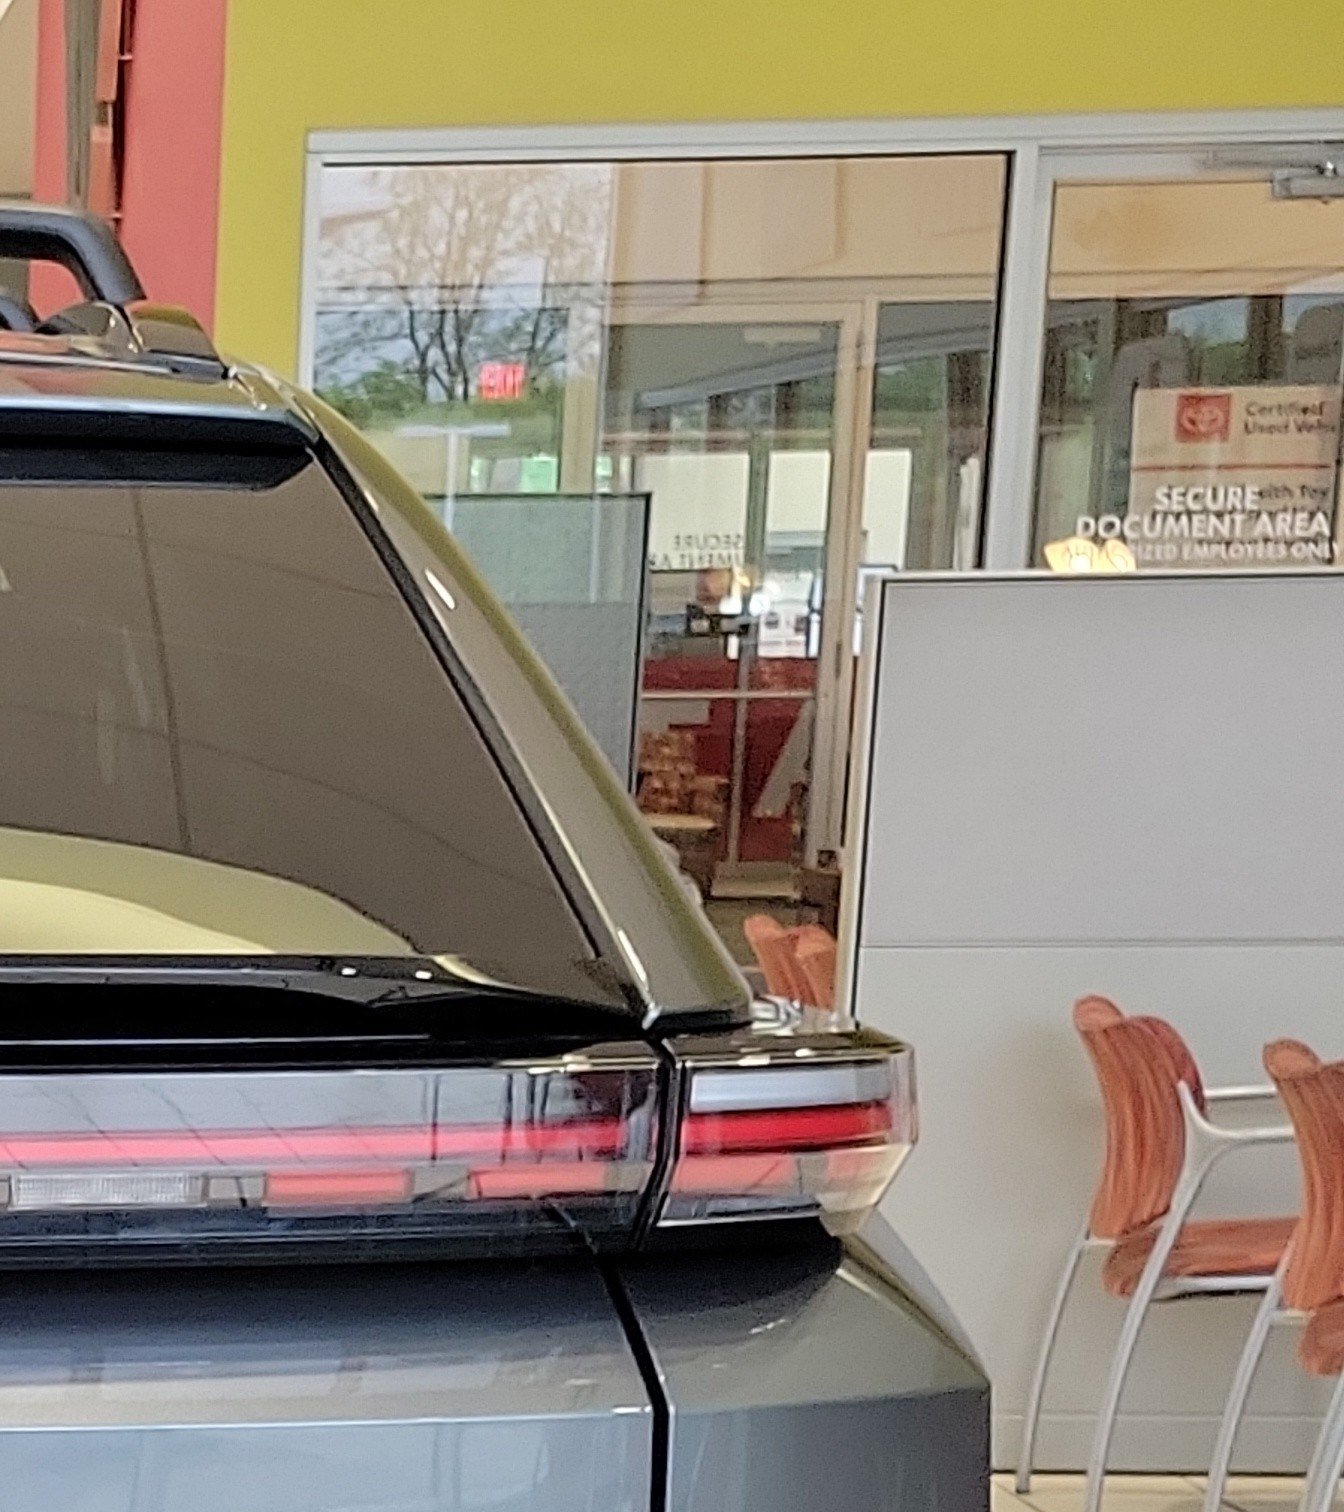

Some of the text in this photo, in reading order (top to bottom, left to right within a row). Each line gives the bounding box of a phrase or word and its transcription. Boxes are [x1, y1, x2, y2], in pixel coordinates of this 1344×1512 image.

[1152, 486, 1261, 512] SECURE
[1075, 510, 1332, 539] DOCUMENT AREA
[1181, 541, 1287, 561] EMPLOYEES
